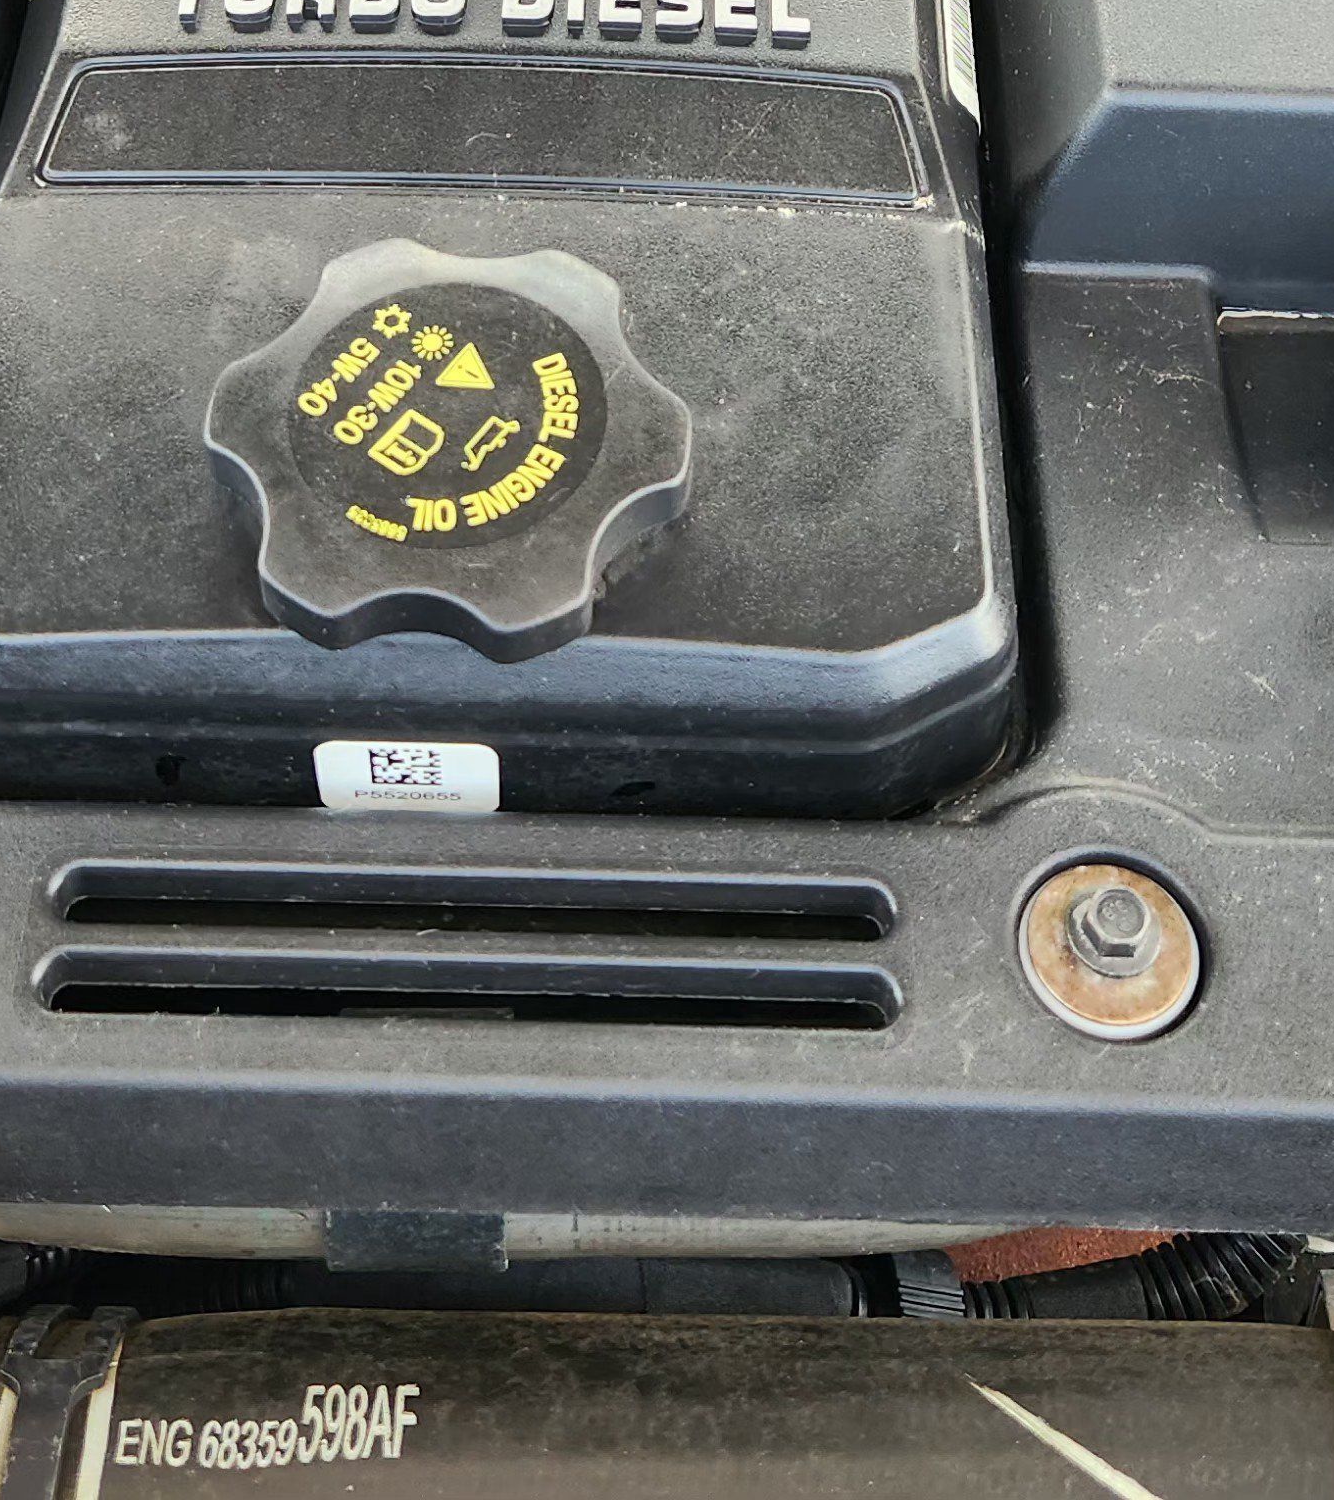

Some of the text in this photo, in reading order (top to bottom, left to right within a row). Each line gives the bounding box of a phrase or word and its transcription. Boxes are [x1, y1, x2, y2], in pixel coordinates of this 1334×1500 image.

[297, 337, 381, 417] 5W-40
[333, 360, 422, 445] 10W-30
[532, 353, 579, 442] DIESEL
[405, 497, 458, 533] OIL
[460, 444, 567, 526] ENGINE
[115, 1418, 194, 1468] ENG
